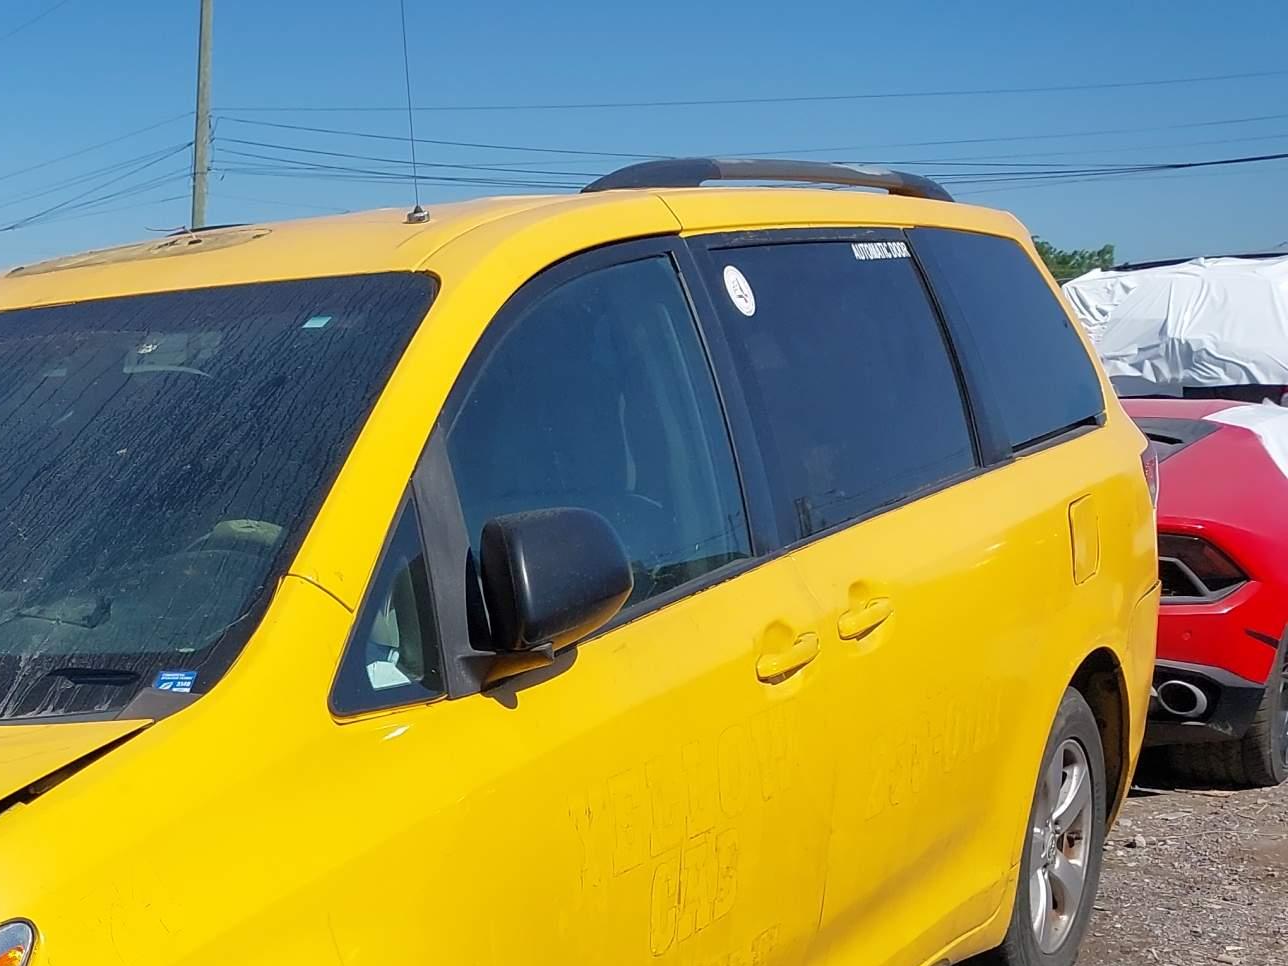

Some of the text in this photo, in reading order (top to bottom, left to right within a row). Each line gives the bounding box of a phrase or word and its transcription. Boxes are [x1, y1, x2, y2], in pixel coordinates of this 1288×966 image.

[851, 242, 911, 260] AUTOMATIC DOOR
[566, 702, 800, 895] YELLOW
[649, 827, 741, 959] CAB
